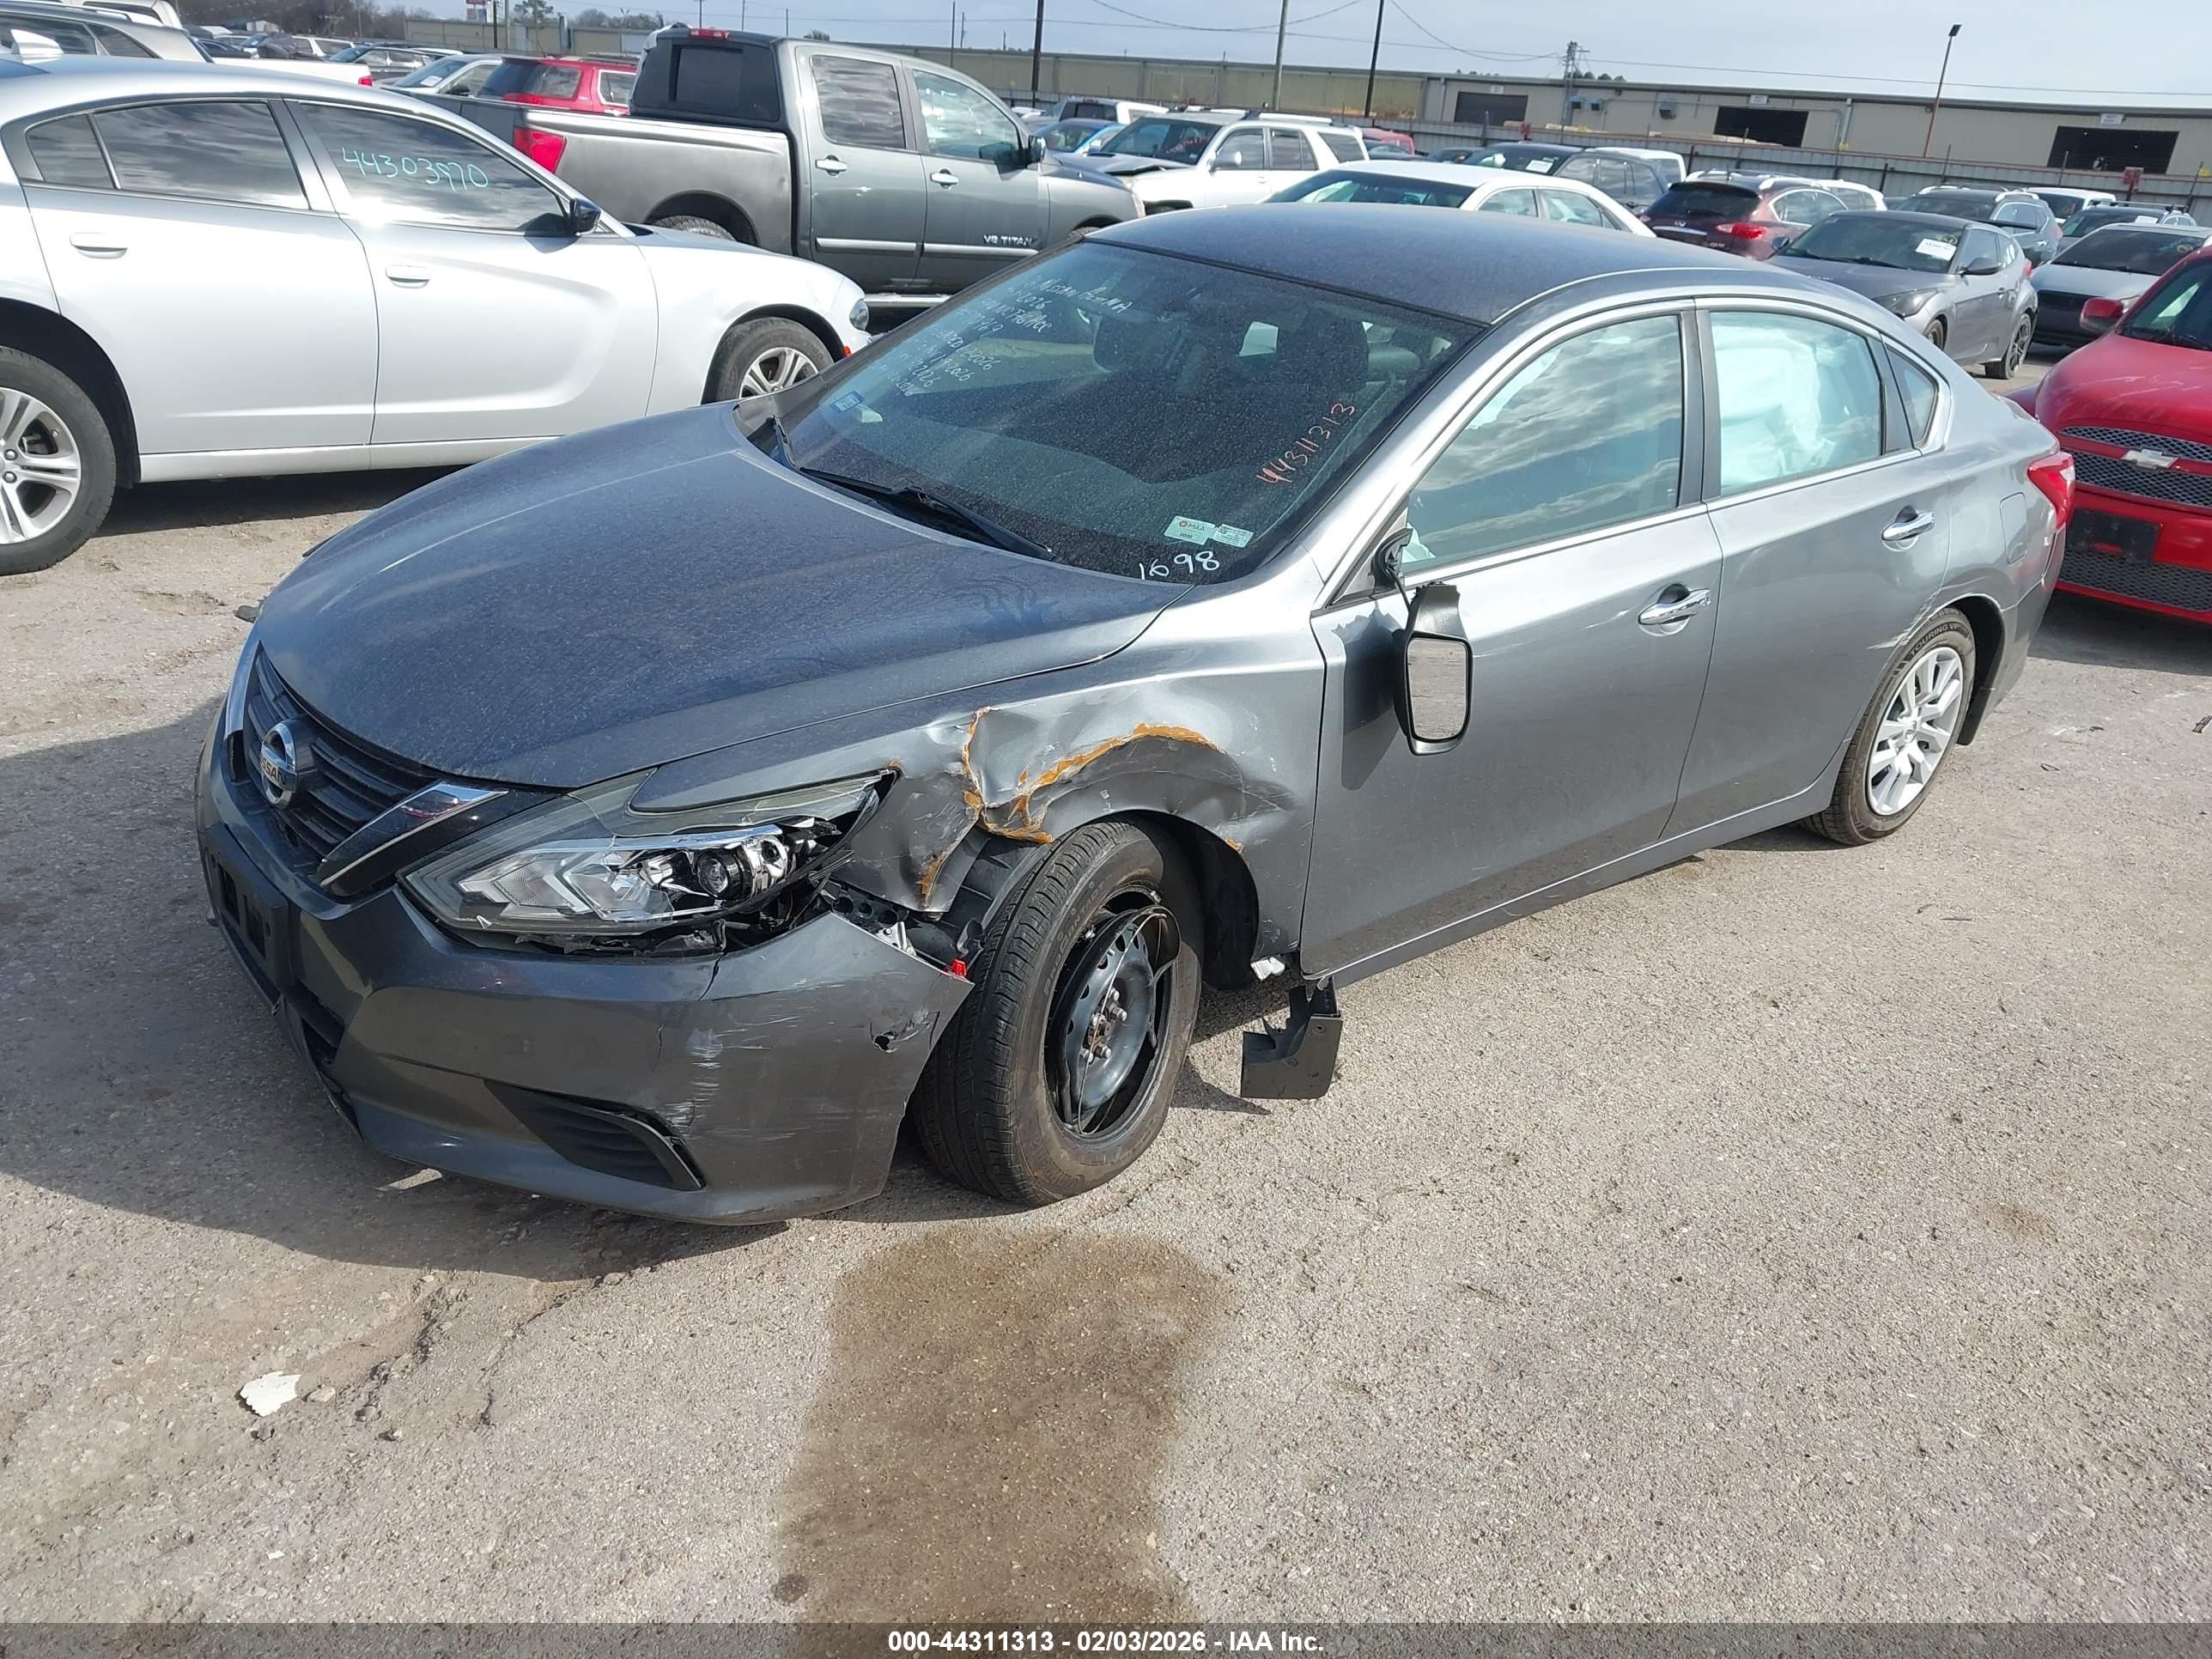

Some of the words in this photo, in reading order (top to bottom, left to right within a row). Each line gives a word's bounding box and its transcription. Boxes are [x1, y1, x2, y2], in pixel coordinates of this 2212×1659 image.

[342, 147, 489, 191] 44303970
[983, 234, 999, 244] V8
[1000, 234, 1033, 246] TITAN
[1255, 402, 1356, 484] 44311313
[1138, 550, 1221, 581] 1698
[1909, 623, 1948, 656] TOURING
[260, 756, 286, 785] SSAN
